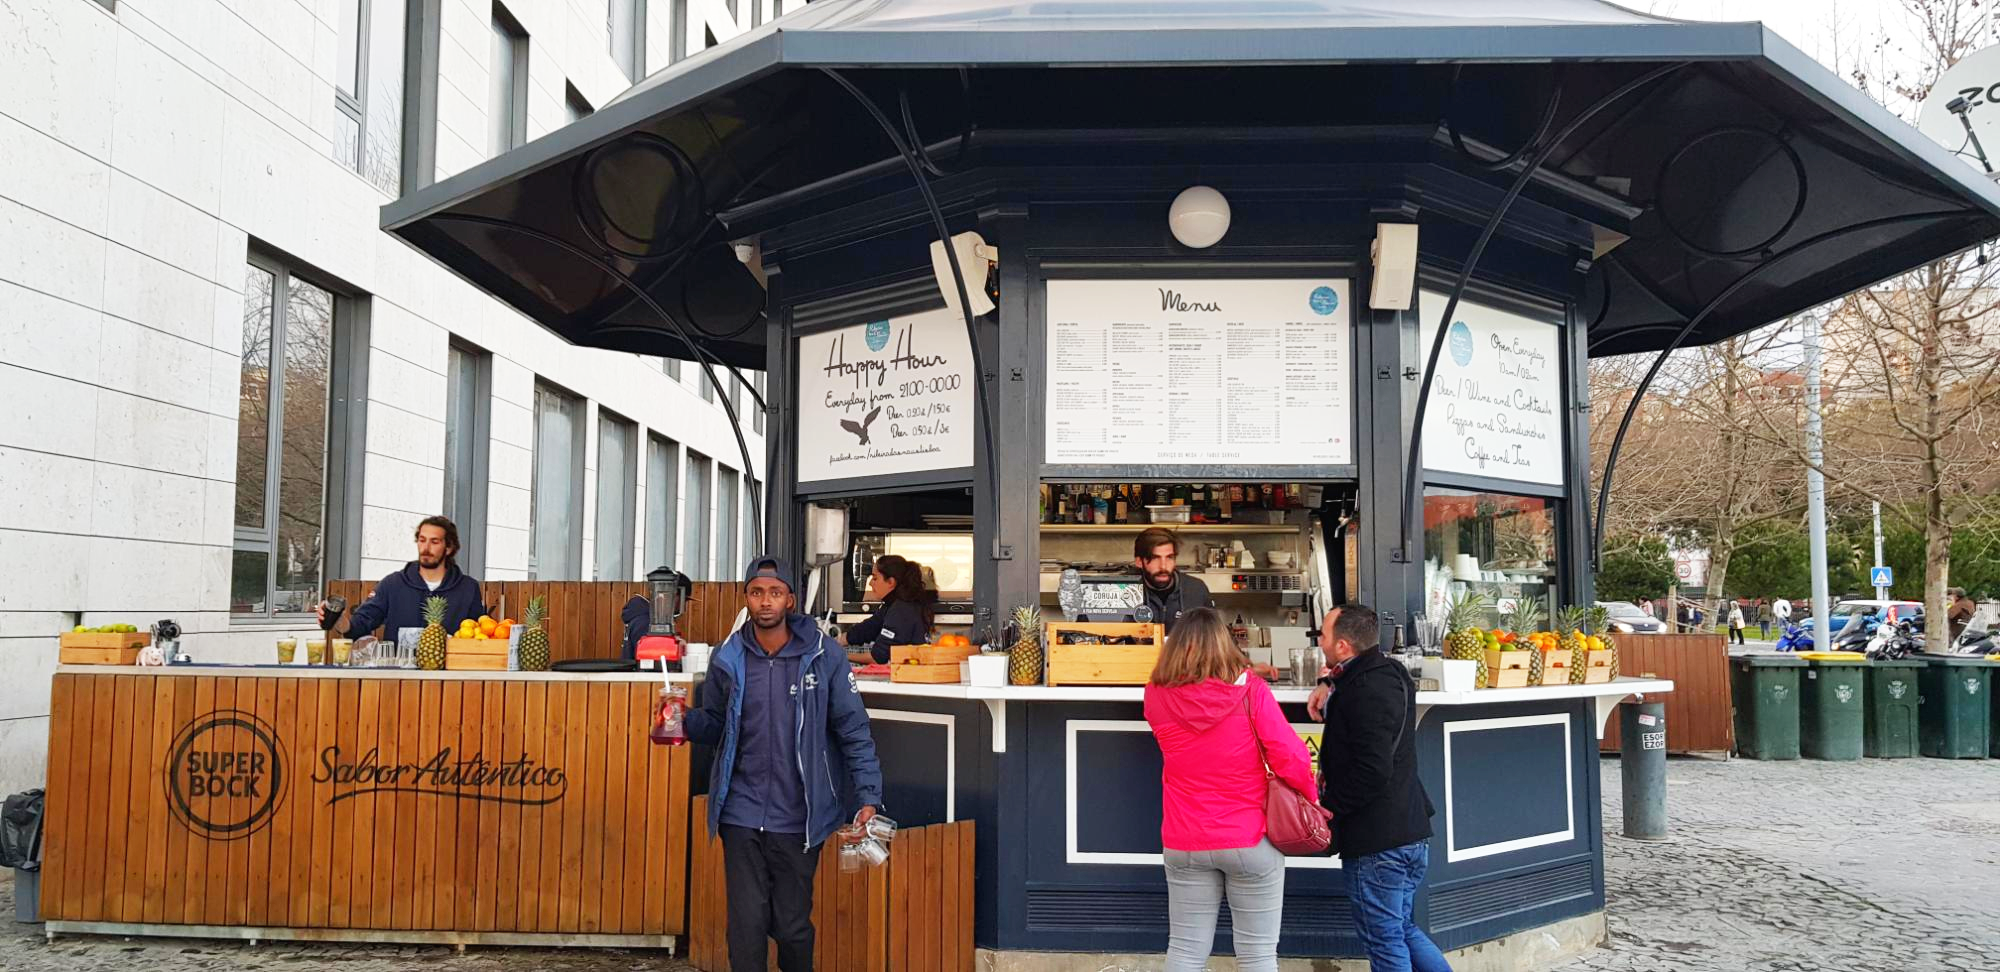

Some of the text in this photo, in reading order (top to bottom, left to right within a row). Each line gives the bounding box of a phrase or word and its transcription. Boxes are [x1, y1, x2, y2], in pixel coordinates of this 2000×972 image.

[1158, 287, 1222, 312] Menu
[824, 323, 947, 389] Happy Hour
[1491, 332, 1512, 360] Open
[1513, 337, 1546, 368] Everyday
[825, 390, 866, 413] Everyday
[869, 389, 895, 410] from
[1434, 374, 1456, 398] Beer
[1465, 378, 1491, 403] Wine
[1493, 394, 1511, 407] and
[1513, 388, 1552, 415] Cocktails
[886, 405, 904, 420] Beer
[1446, 403, 1546, 440] Pizzas and Sandwiches
[890, 423, 908, 439] Beer
[1465, 436, 1531, 469] Coffee and Teas
[1093, 592, 1118, 600] CORUJA
[187, 751, 265, 774] SUPER
[310, 746, 566, 787] Sabor Autêntico
[190, 775, 260, 798] BOCK
